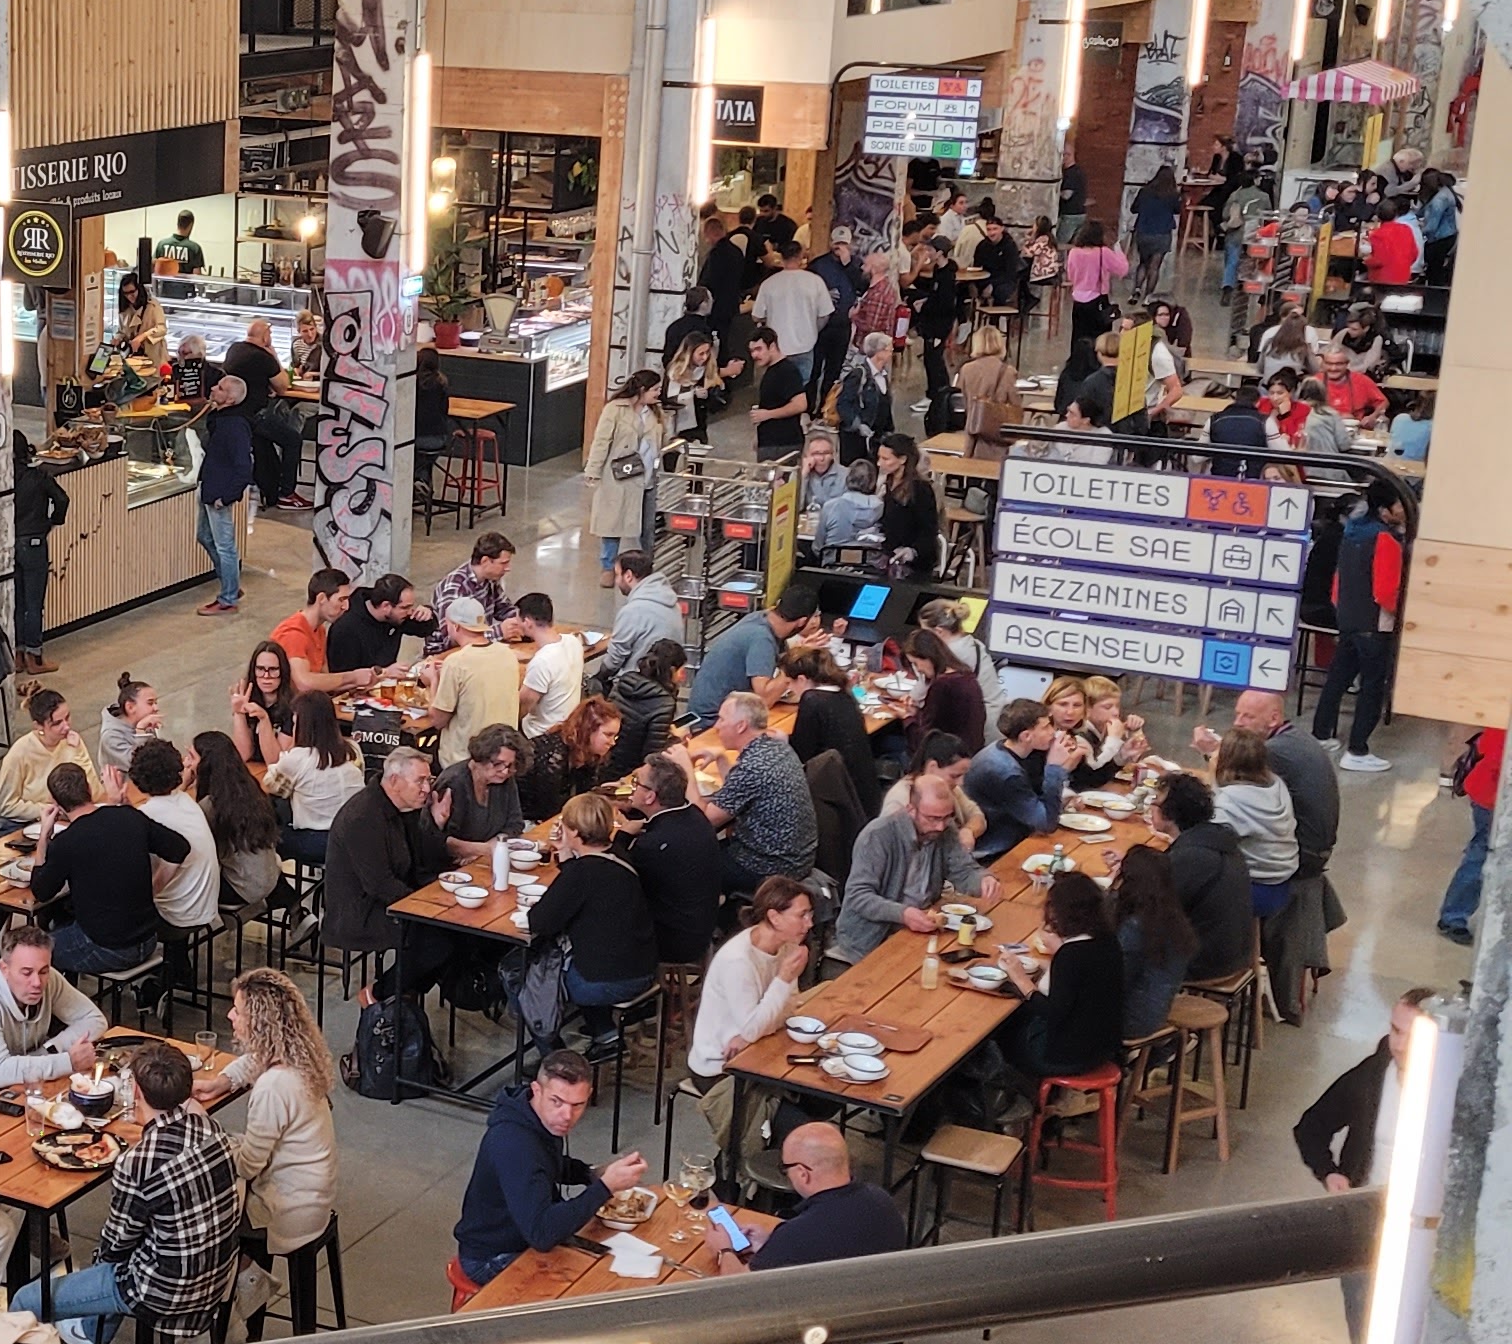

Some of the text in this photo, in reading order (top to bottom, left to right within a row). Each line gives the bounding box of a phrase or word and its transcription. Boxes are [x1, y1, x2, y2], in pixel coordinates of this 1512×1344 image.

[875, 79, 935, 91] TOILETTES
[714, 99, 756, 122] TATA
[874, 99, 931, 111] FORUM
[871, 140, 927, 153] SORTIE SUD
[93, 151, 127, 183] RIO
[163, 244, 189, 262] TATA
[1020, 470, 1171, 507] TOILETTES
[1012, 516, 1192, 564] ÉCOLE SAE
[1009, 573, 1189, 616] MEZZANINES
[1005, 624, 1186, 668] ASCENSEUR
